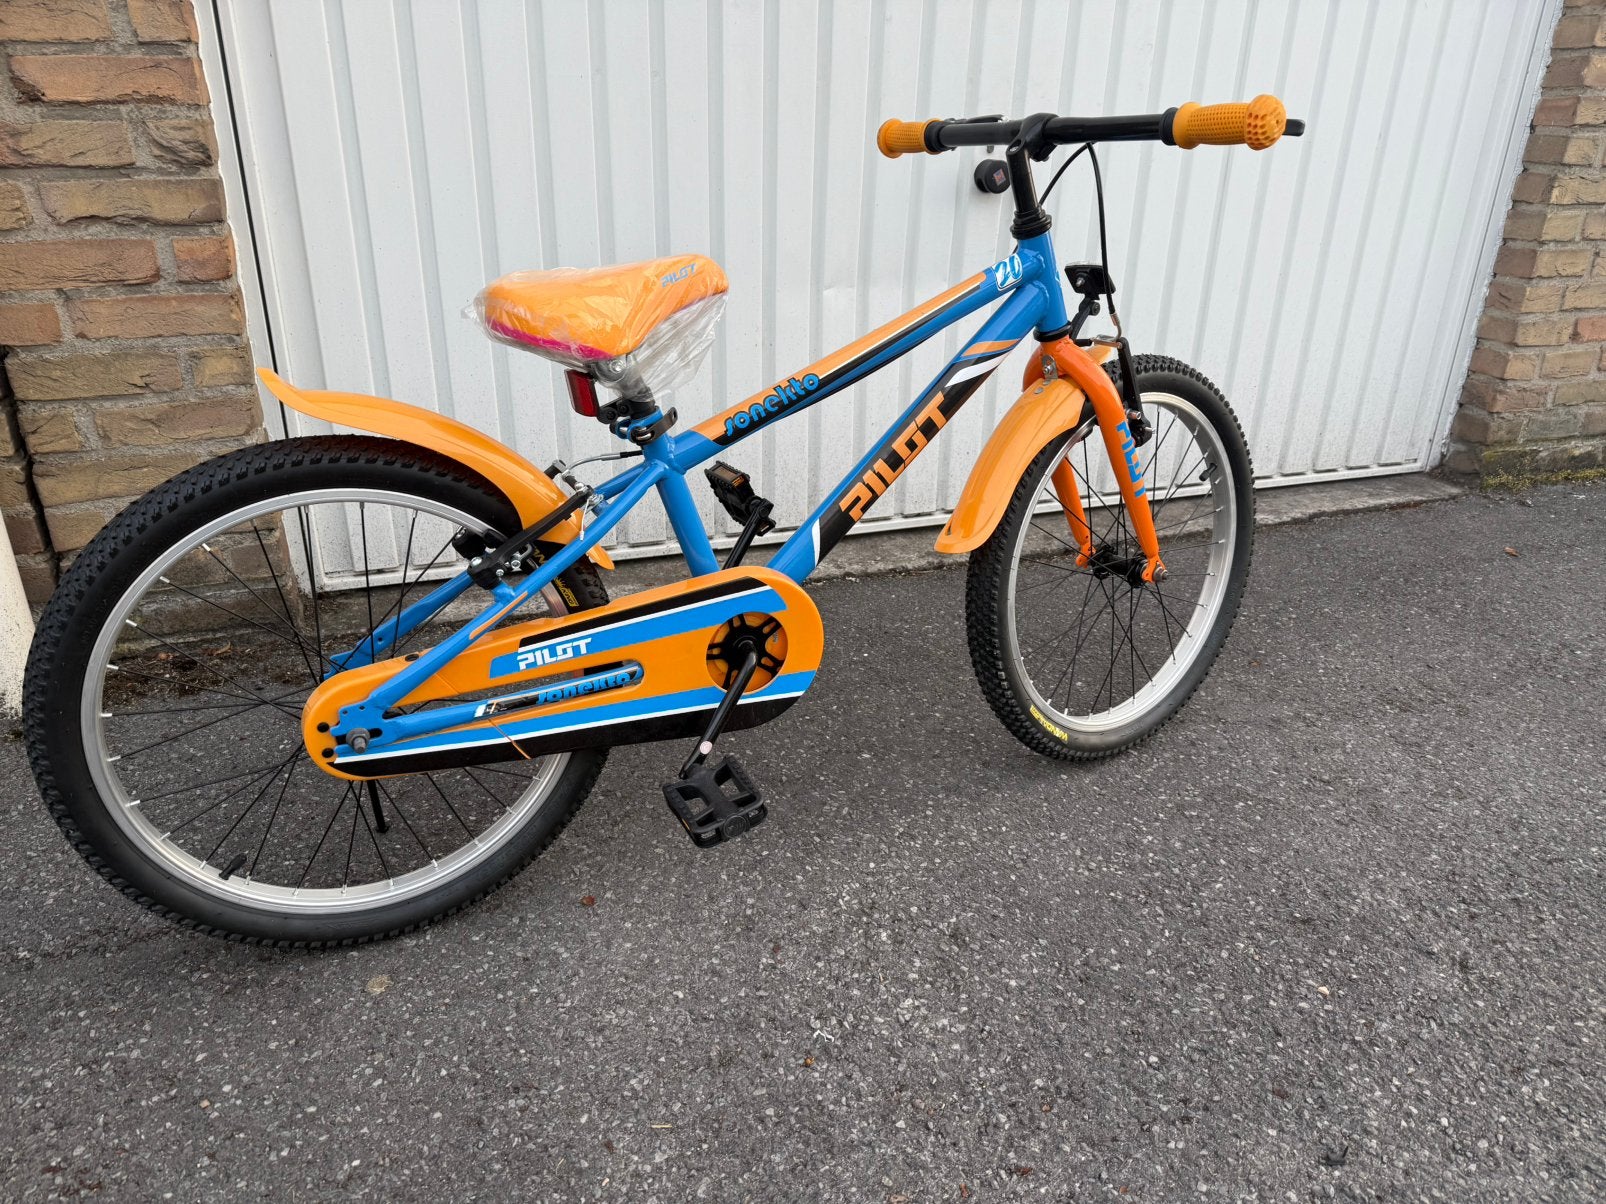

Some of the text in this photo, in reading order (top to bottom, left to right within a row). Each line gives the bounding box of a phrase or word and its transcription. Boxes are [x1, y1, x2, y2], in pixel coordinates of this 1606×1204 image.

[660, 263, 696, 288] PILOT
[995, 255, 1021, 287] 20
[839, 391, 947, 522] PILOT
[517, 638, 592, 671] PILOT
